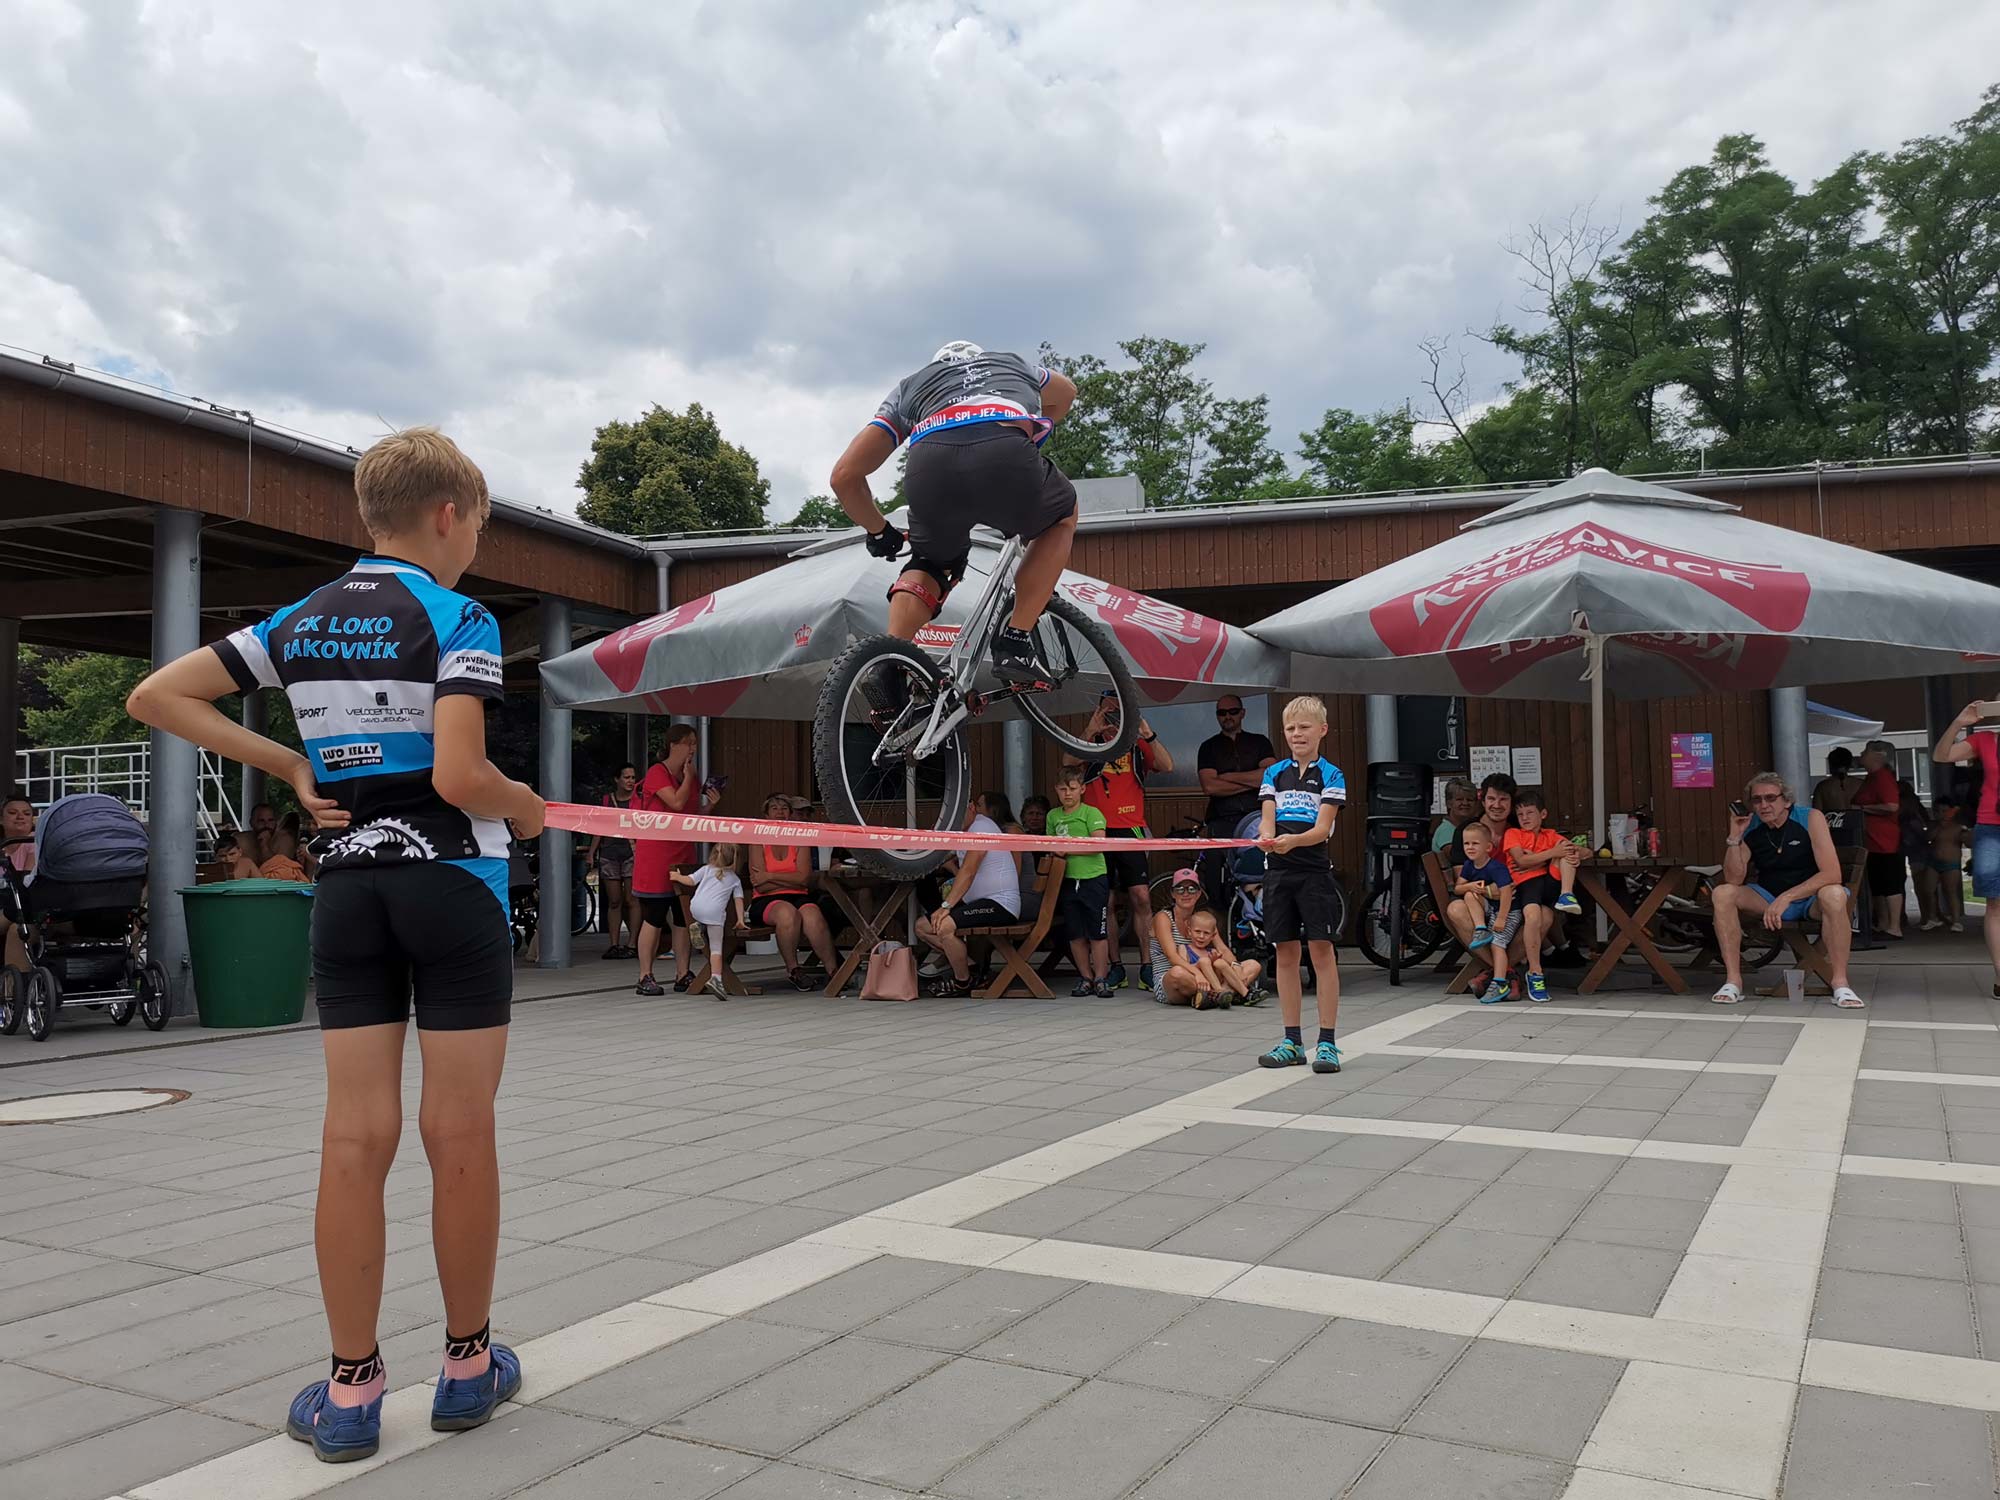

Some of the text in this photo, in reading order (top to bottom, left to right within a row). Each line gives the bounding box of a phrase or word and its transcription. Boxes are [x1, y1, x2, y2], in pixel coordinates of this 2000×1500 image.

[914, 414, 947, 435] TRENUJ
[954, 411, 971, 423] SPI
[978, 407, 996, 418] JEZ
[342, 581, 380, 590] ATEX
[294, 615, 393, 635] CK LOKO
[283, 636, 401, 663] RAKOVNÍK
[299, 706, 328, 719] SPORT
[349, 745, 379, 756] KELLY
[446, 1330, 487, 1360] OX
